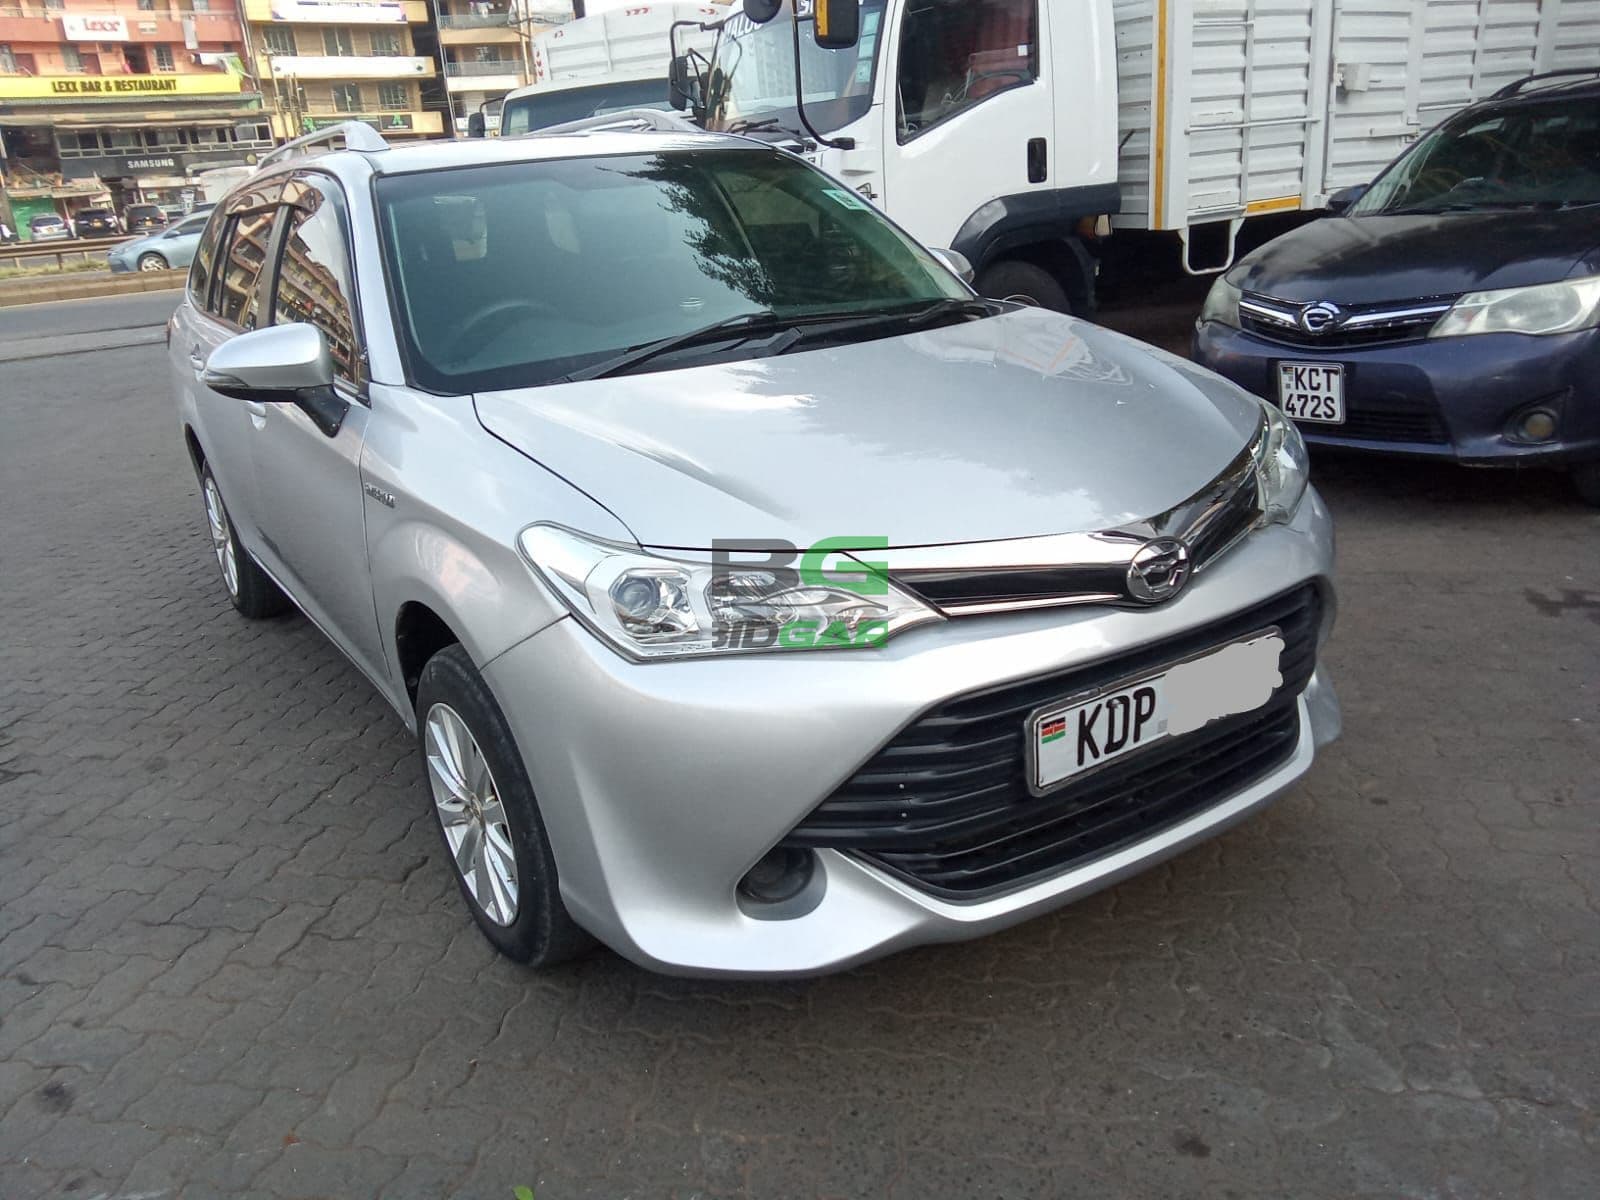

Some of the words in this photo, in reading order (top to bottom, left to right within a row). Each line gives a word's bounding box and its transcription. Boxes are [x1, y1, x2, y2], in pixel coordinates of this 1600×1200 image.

[51, 80, 79, 93] LEXX
[80, 80, 102, 93] BAR
[104, 80, 113, 92] &
[114, 79, 177, 92] RESTAURANT
[127, 158, 175, 169] SAMSUNG
[1294, 367, 1339, 392] KCT
[1285, 393, 1336, 419] 472S
[1077, 686, 1157, 767] KDP
